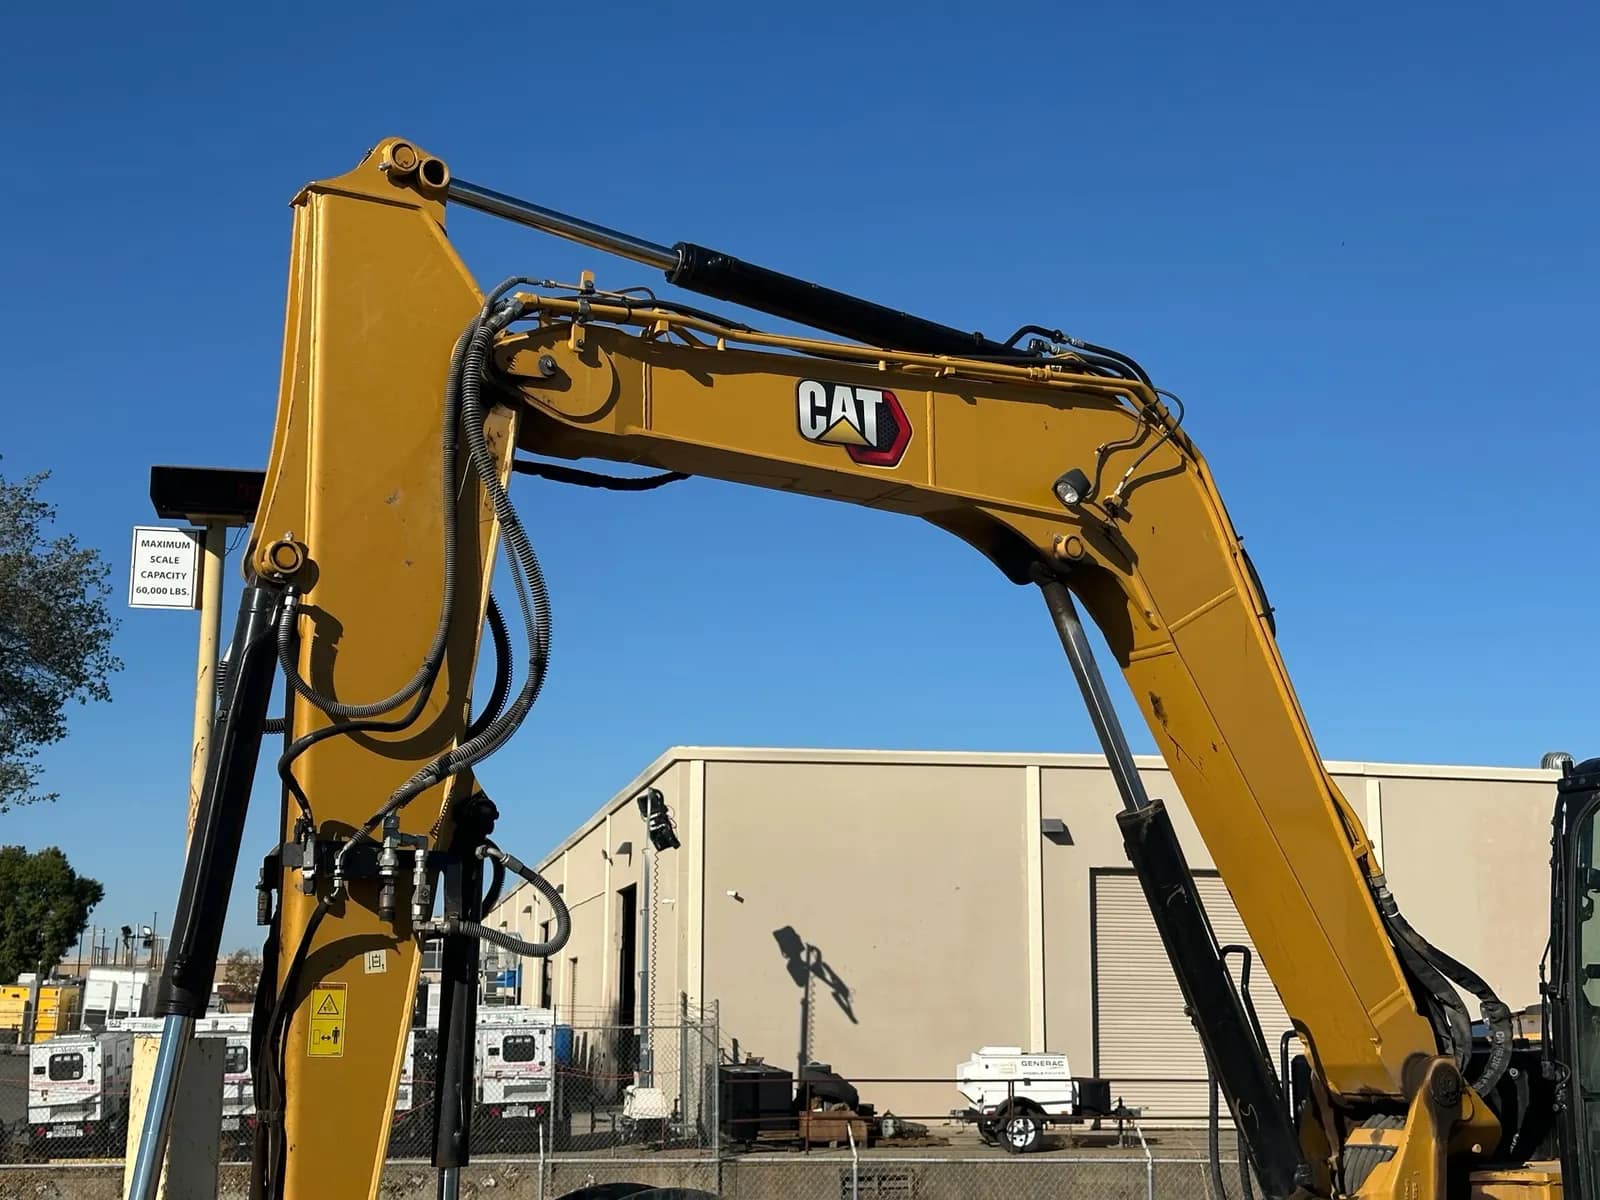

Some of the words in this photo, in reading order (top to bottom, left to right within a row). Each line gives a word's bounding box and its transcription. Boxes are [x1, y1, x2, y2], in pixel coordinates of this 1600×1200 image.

[799, 381, 882, 447] CAT
[141, 540, 191, 549] MAXIMUM
[150, 556, 180, 564] SCALE
[141, 571, 187, 580] CAPACITY
[136, 587, 168, 595] 60,000
[169, 588, 190, 596] LBS.
